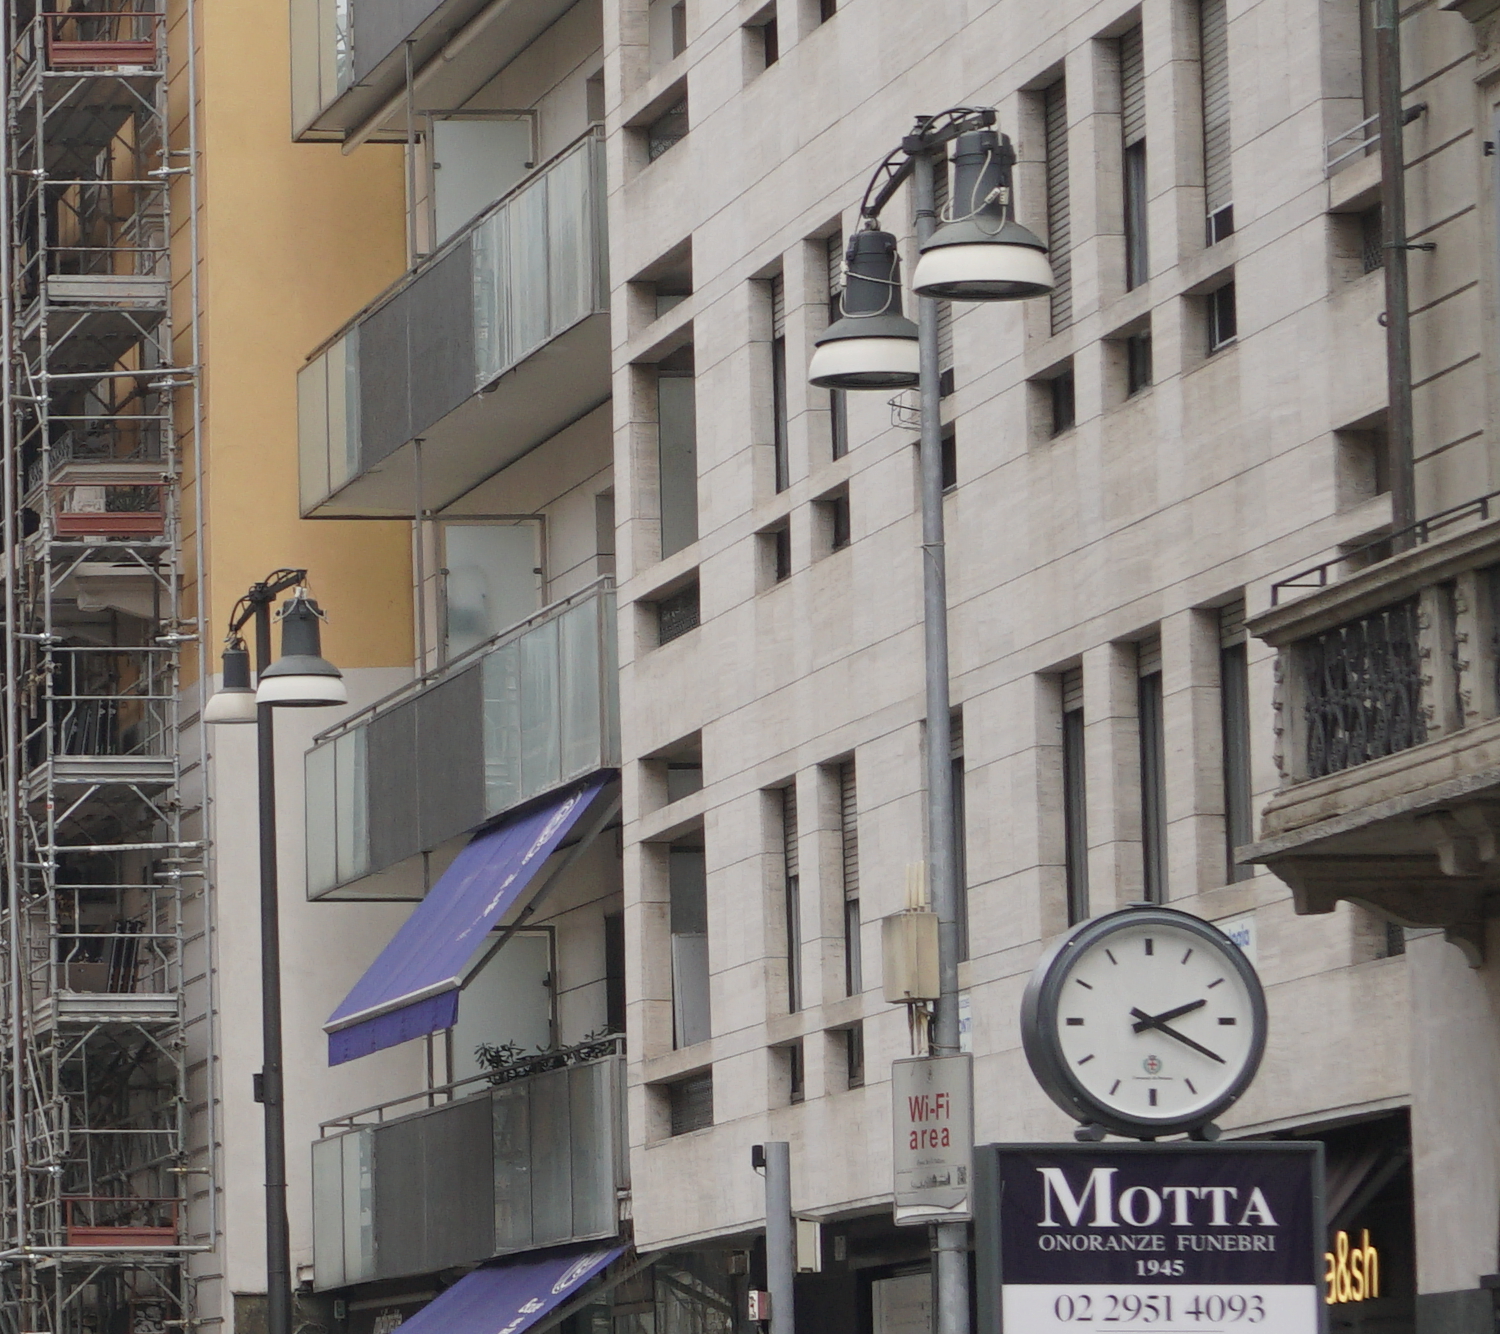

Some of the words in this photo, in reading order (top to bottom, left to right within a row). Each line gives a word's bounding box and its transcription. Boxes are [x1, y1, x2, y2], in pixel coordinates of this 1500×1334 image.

[908, 1093, 950, 1122] Wi-Fi
[909, 1127, 951, 1150] area
[1036, 1167, 1280, 1227] MOTTA
[1038, 1234, 1166, 1252] ONORANZE
[1177, 1234, 1277, 1252] FUNEBRI
[1135, 1259, 1185, 1276] 1945
[1054, 1294, 1094, 1323] 02
[1102, 1293, 1173, 1323] 2951
[1185, 1294, 1267, 1323] 4093
